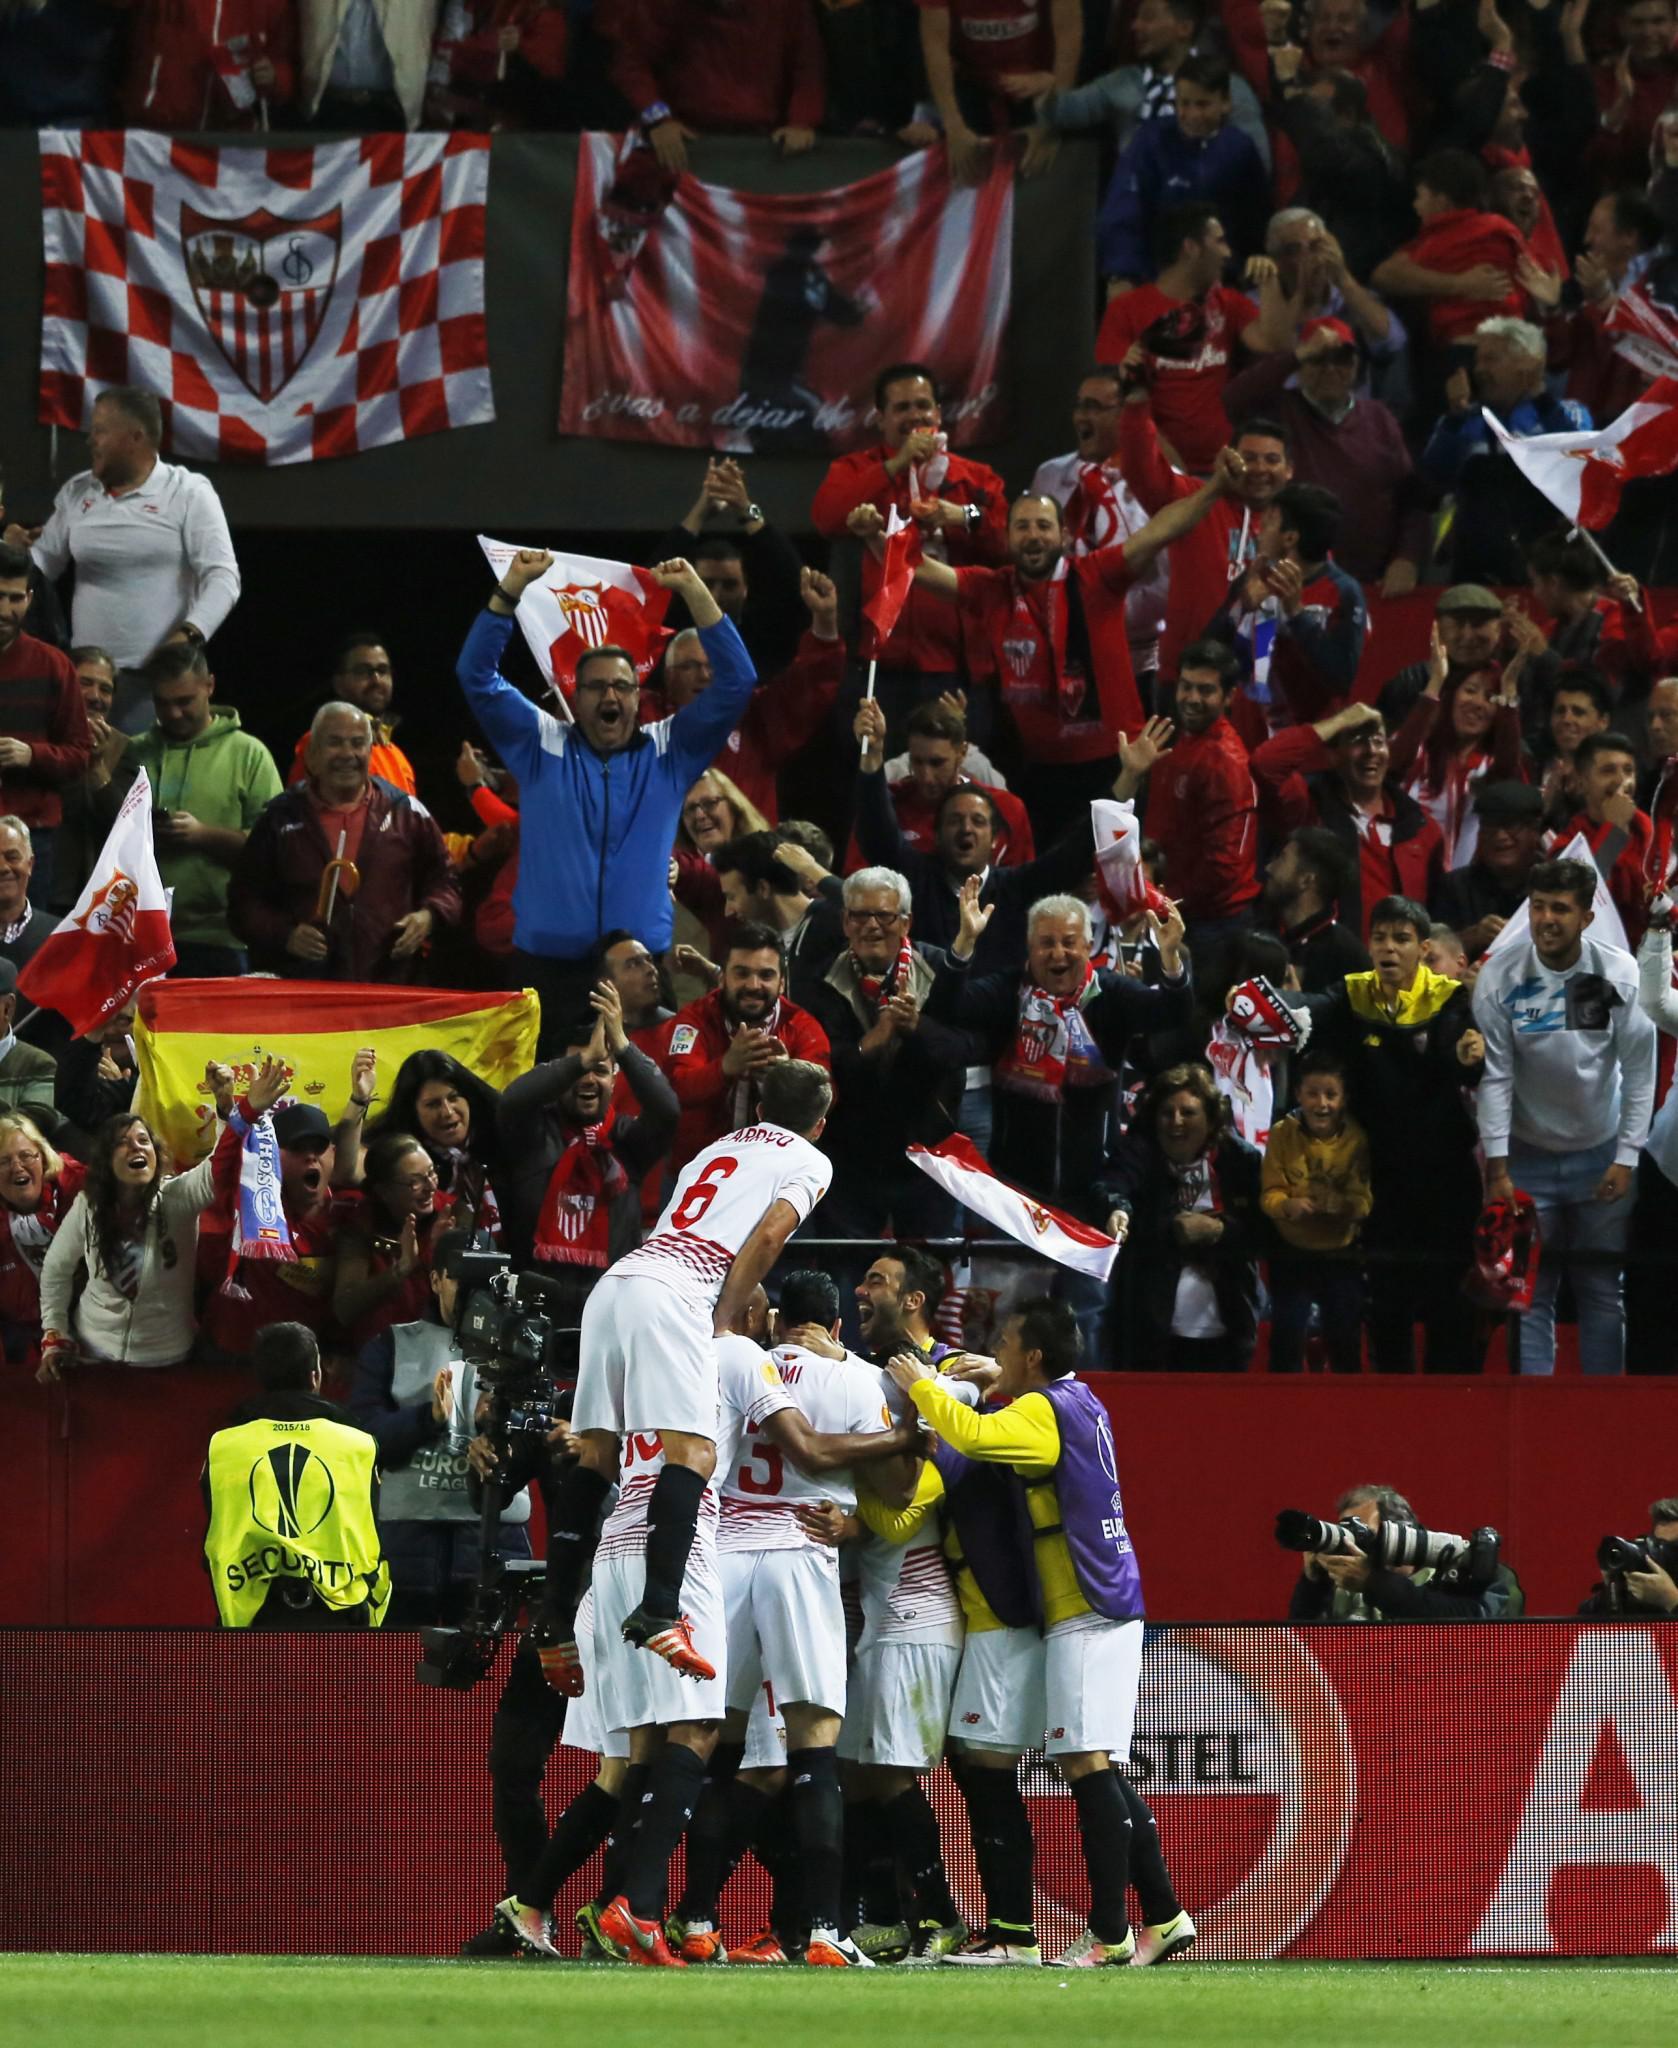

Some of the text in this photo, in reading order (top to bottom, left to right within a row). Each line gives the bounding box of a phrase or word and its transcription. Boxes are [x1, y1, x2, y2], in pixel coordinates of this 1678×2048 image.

[675, 402, 702, 424] a
[711, 391, 806, 433] dejar
[671, 1043, 689, 1054] LFP
[671, 1156, 738, 1230] 6
[272, 1422, 311, 1432] 2015/18
[409, 1449, 471, 1475] EURO
[418, 1474, 469, 1491] LEAG
